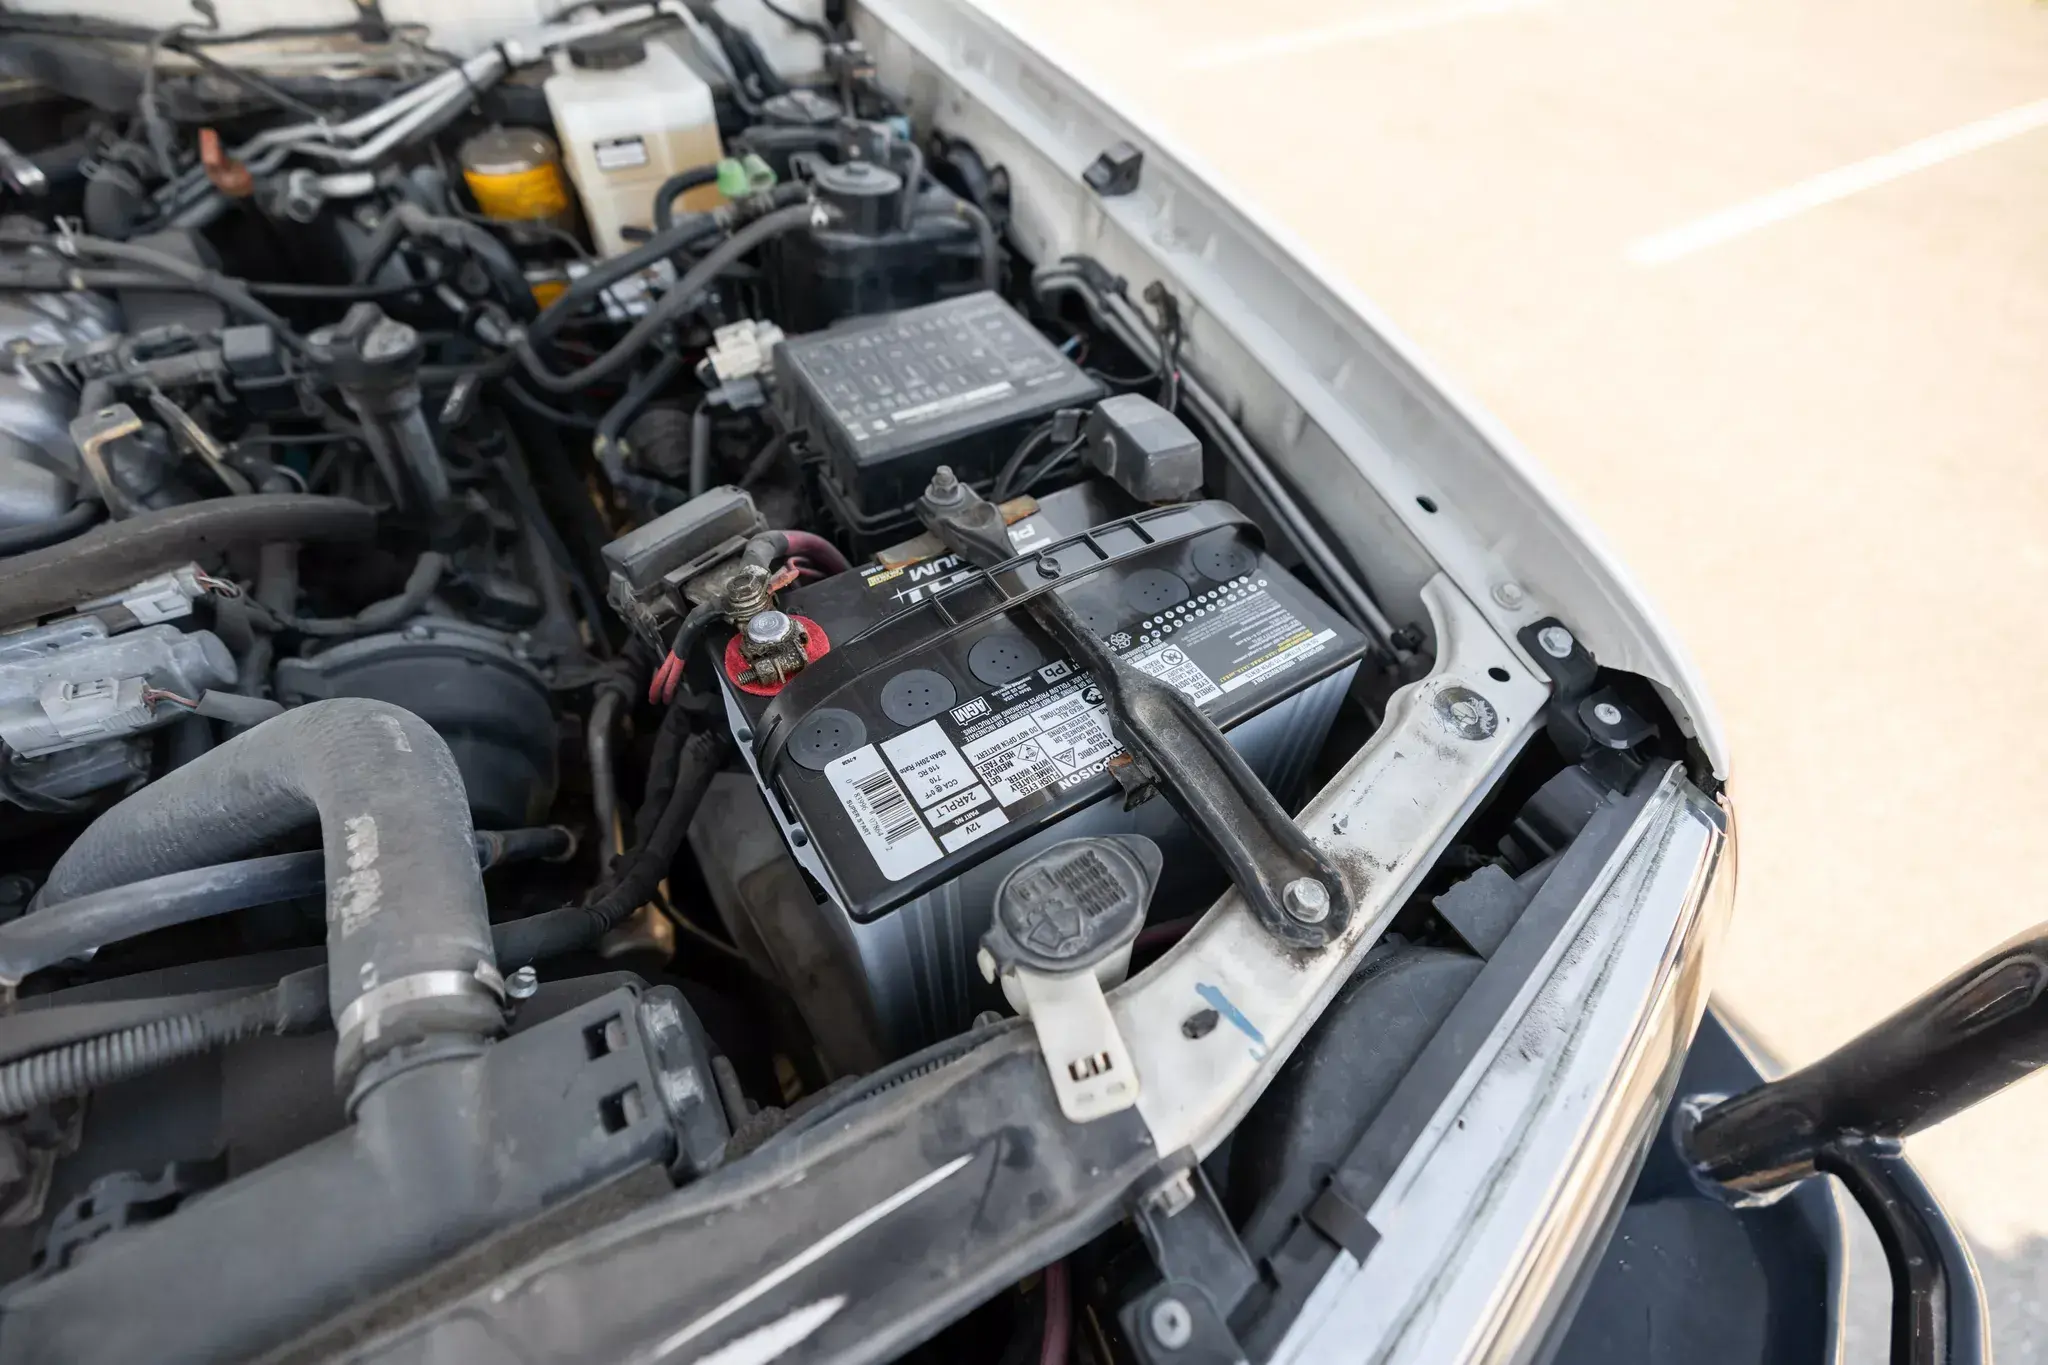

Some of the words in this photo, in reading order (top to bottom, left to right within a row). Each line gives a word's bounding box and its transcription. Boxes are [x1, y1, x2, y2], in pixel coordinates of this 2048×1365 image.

[1141, 658, 1160, 670] REACH
[1185, 666, 1197, 675] CAN
[1043, 663, 1066, 679] Pb
[1168, 672, 1186, 684] CAUSE
[1173, 672, 1203, 690] EXPLOSIV
[1190, 677, 1209, 691] EYES.
[1018, 686, 1031, 694] Made
[1048, 681, 1070, 694] FOLLOW
[1193, 683, 1216, 699] SHIELD
[1027, 691, 1049, 704] PROPER
[1039, 697, 1051, 706] NOT
[1049, 693, 1059, 701] DO
[951, 698, 987, 722] AGM
[1000, 700, 1029, 717] CHARGING
[1003, 702, 1040, 723] DISASSEMBLE
[1037, 698, 1080, 722] INSTRUCTIONS.
[1067, 703, 1084, 715] READ
[1057, 711, 1069, 720] ALL
[1065, 714, 1088, 728] SEVERE
[960, 713, 1002, 736] INSTRUCTIONS.
[995, 719, 1005, 727] OR
[1027, 725, 1038, 734] DO
[1061, 720, 1093, 739] BLINDNESS
[962, 723, 996, 743] INCINERATE.
[1016, 730, 1029, 740] NOT
[1044, 724, 1067, 739] BURNS.
[1084, 726, 1098, 736] CAN
[1000, 736, 1017, 747] OPEN
[1052, 735, 1062, 743] OR
[1066, 732, 1086, 745] CAUSE
[1086, 732, 1103, 745] ACID
[928, 748, 946, 760] 65Ah
[973, 743, 1001, 760] BATTERY.
[1076, 739, 1110, 760] SULFURIC
[913, 756, 930, 768] 20Hr
[996, 750, 1015, 763] HELP
[898, 763, 915, 775] Rate
[927, 763, 939, 772] 110
[976, 759, 997, 773] FAST.
[981, 760, 1013, 780] MEDICAL
[1030, 758, 1049, 771] WITH
[917, 768, 928, 777] RC
[928, 774, 941, 784] 710
[1004, 767, 1031, 785] WATER.
[1008, 764, 1055, 792] IMMEDIATELY
[1037, 771, 1060, 787] FLUSH
[942, 778, 958, 789] CCA
[986, 774, 1002, 786] GET
[933, 783, 943, 793] @
[1019, 782, 1038, 796] EYES
[853, 792, 868, 811] 83996
[933, 791, 976, 818] 24RPLT
[845, 798, 860, 818] SUPER
[856, 817, 870, 836] START
[952, 816, 964, 826] NO.
[963, 809, 979, 820] PART
[963, 821, 981, 834] 12V
